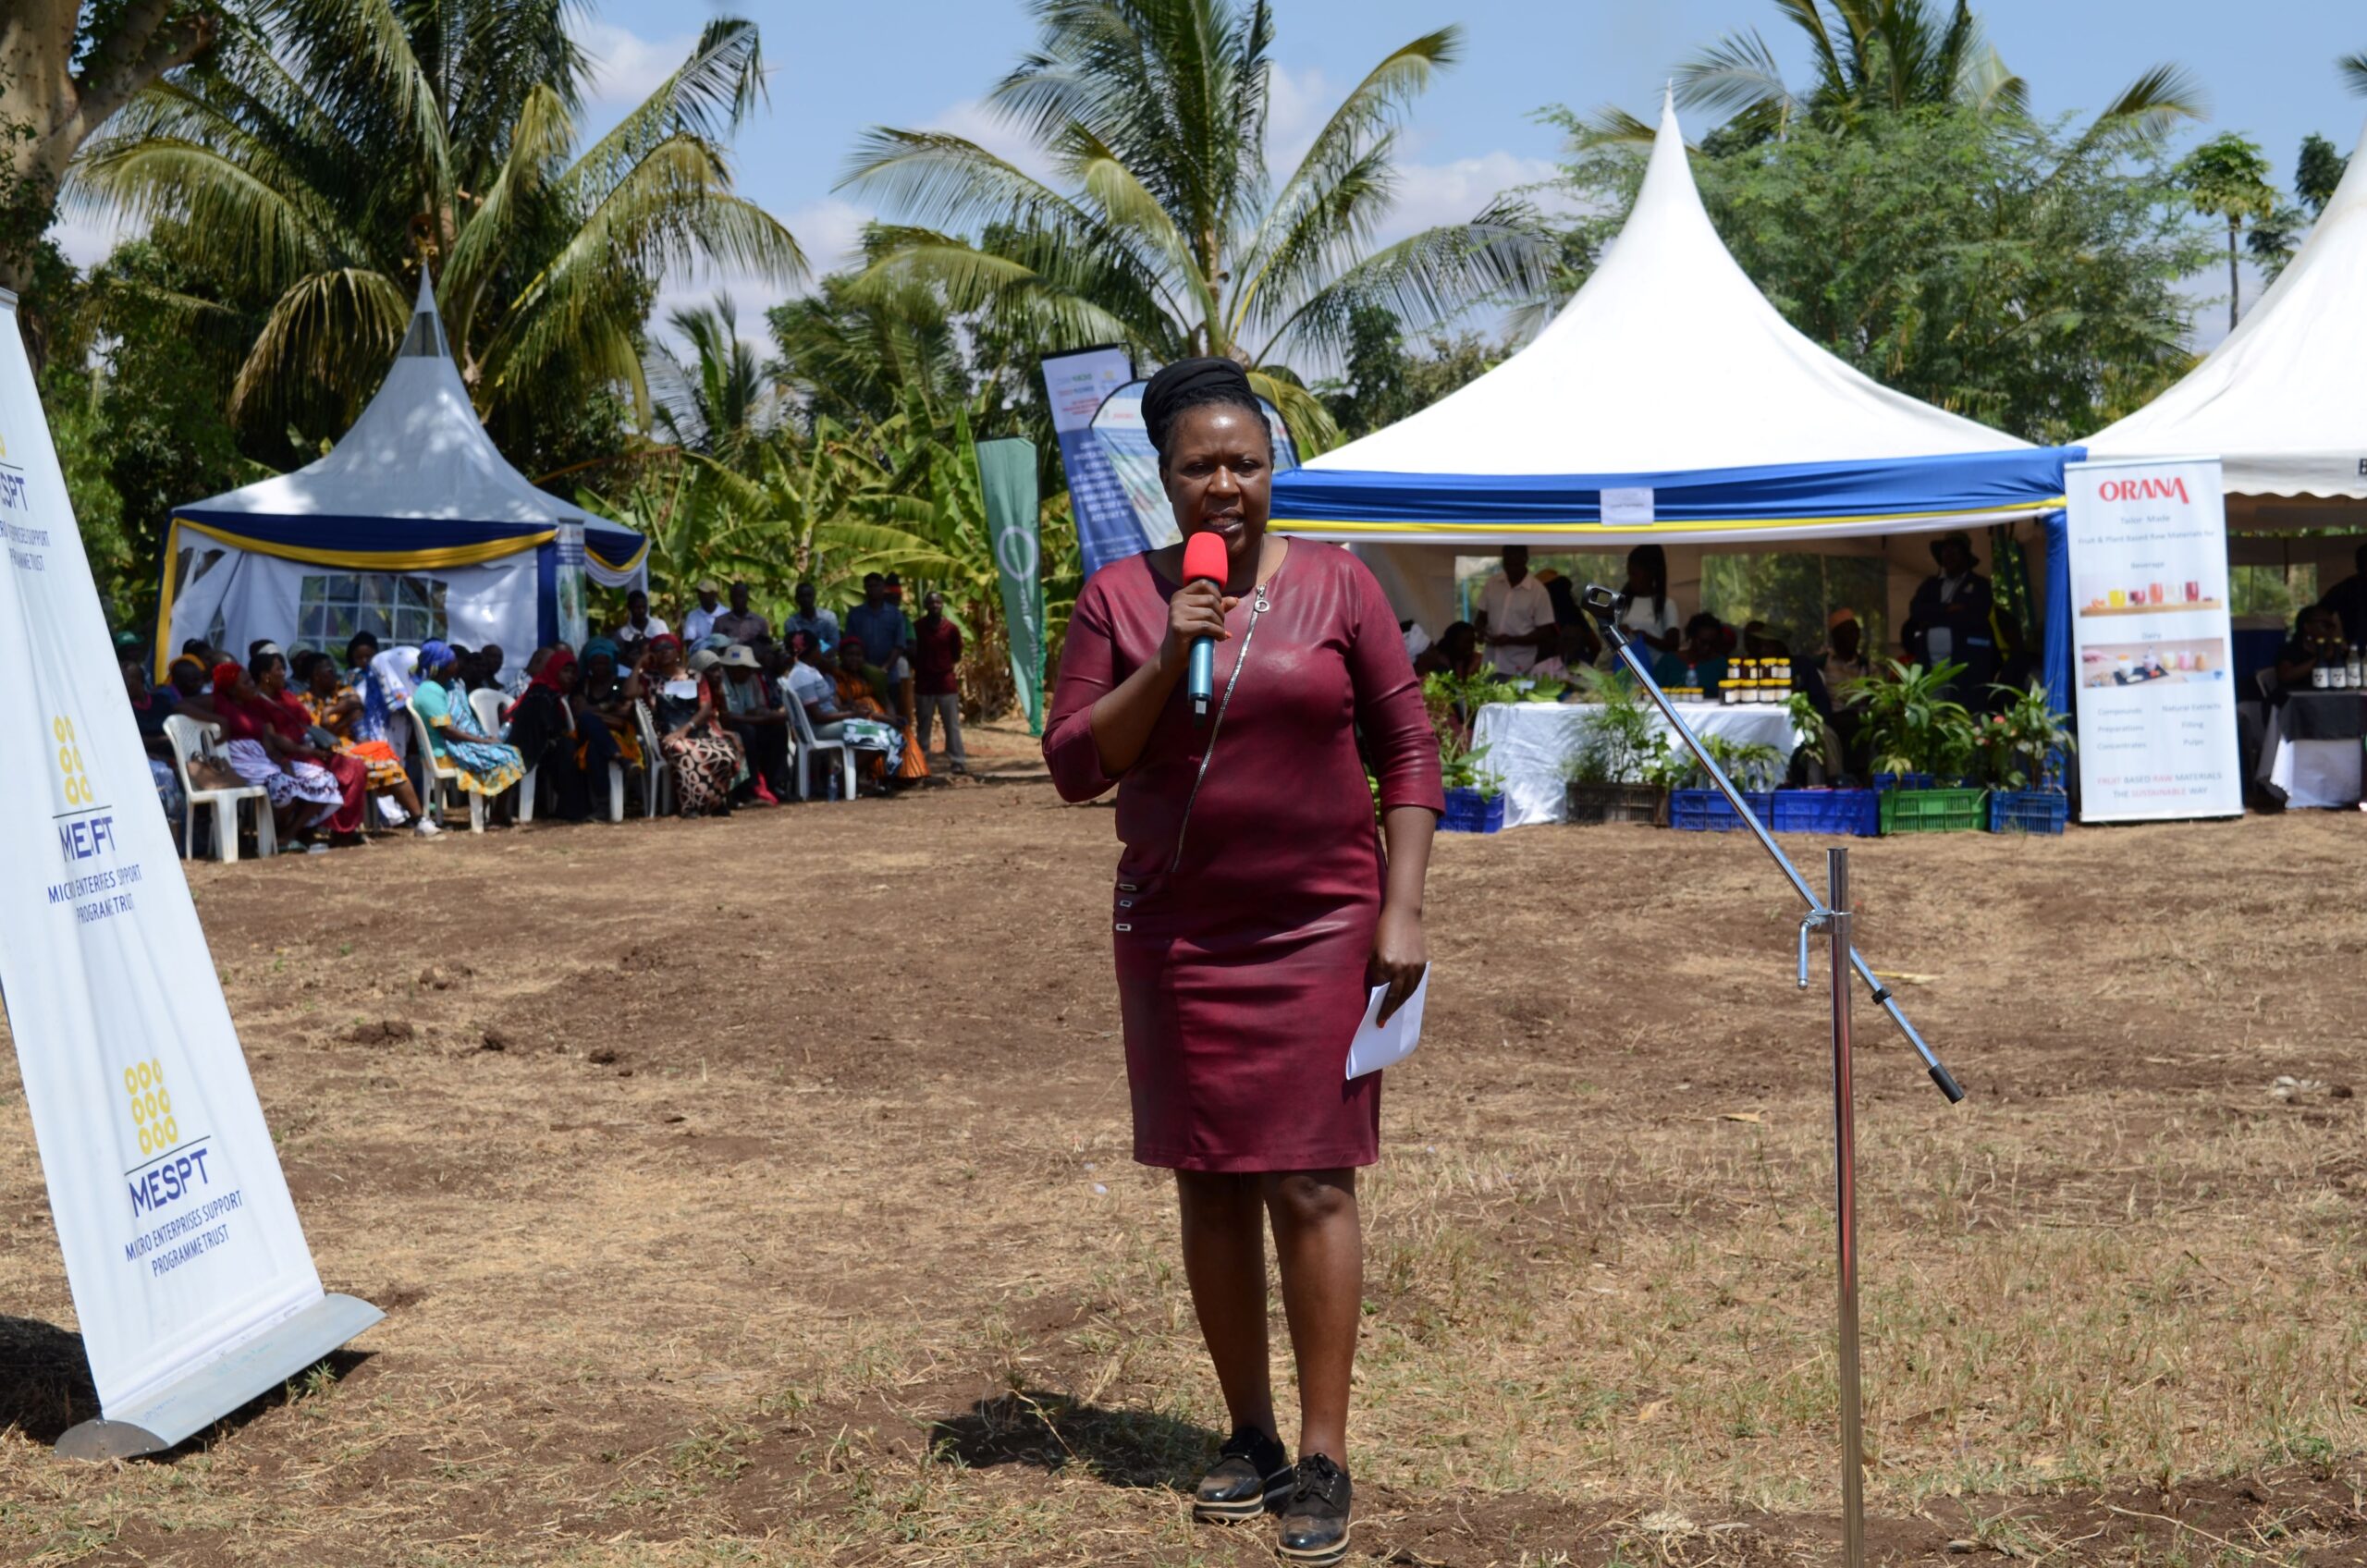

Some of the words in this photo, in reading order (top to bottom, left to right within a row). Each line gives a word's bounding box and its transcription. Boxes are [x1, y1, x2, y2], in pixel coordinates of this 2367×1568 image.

[0, 472, 28, 511] SPT
[2099, 477, 2189, 505] ORANA
[2147, 515, 2171, 523] Made
[2175, 772, 2223, 782] MATERIALS
[129, 1147, 208, 1218] MESPT
[125, 1234, 153, 1263] MICRO
[153, 1208, 203, 1248] ENTERPRISES
[202, 1190, 243, 1222] SUPPORT
[152, 1237, 204, 1278] PROGRAMME
[202, 1223, 229, 1251] TRUST
